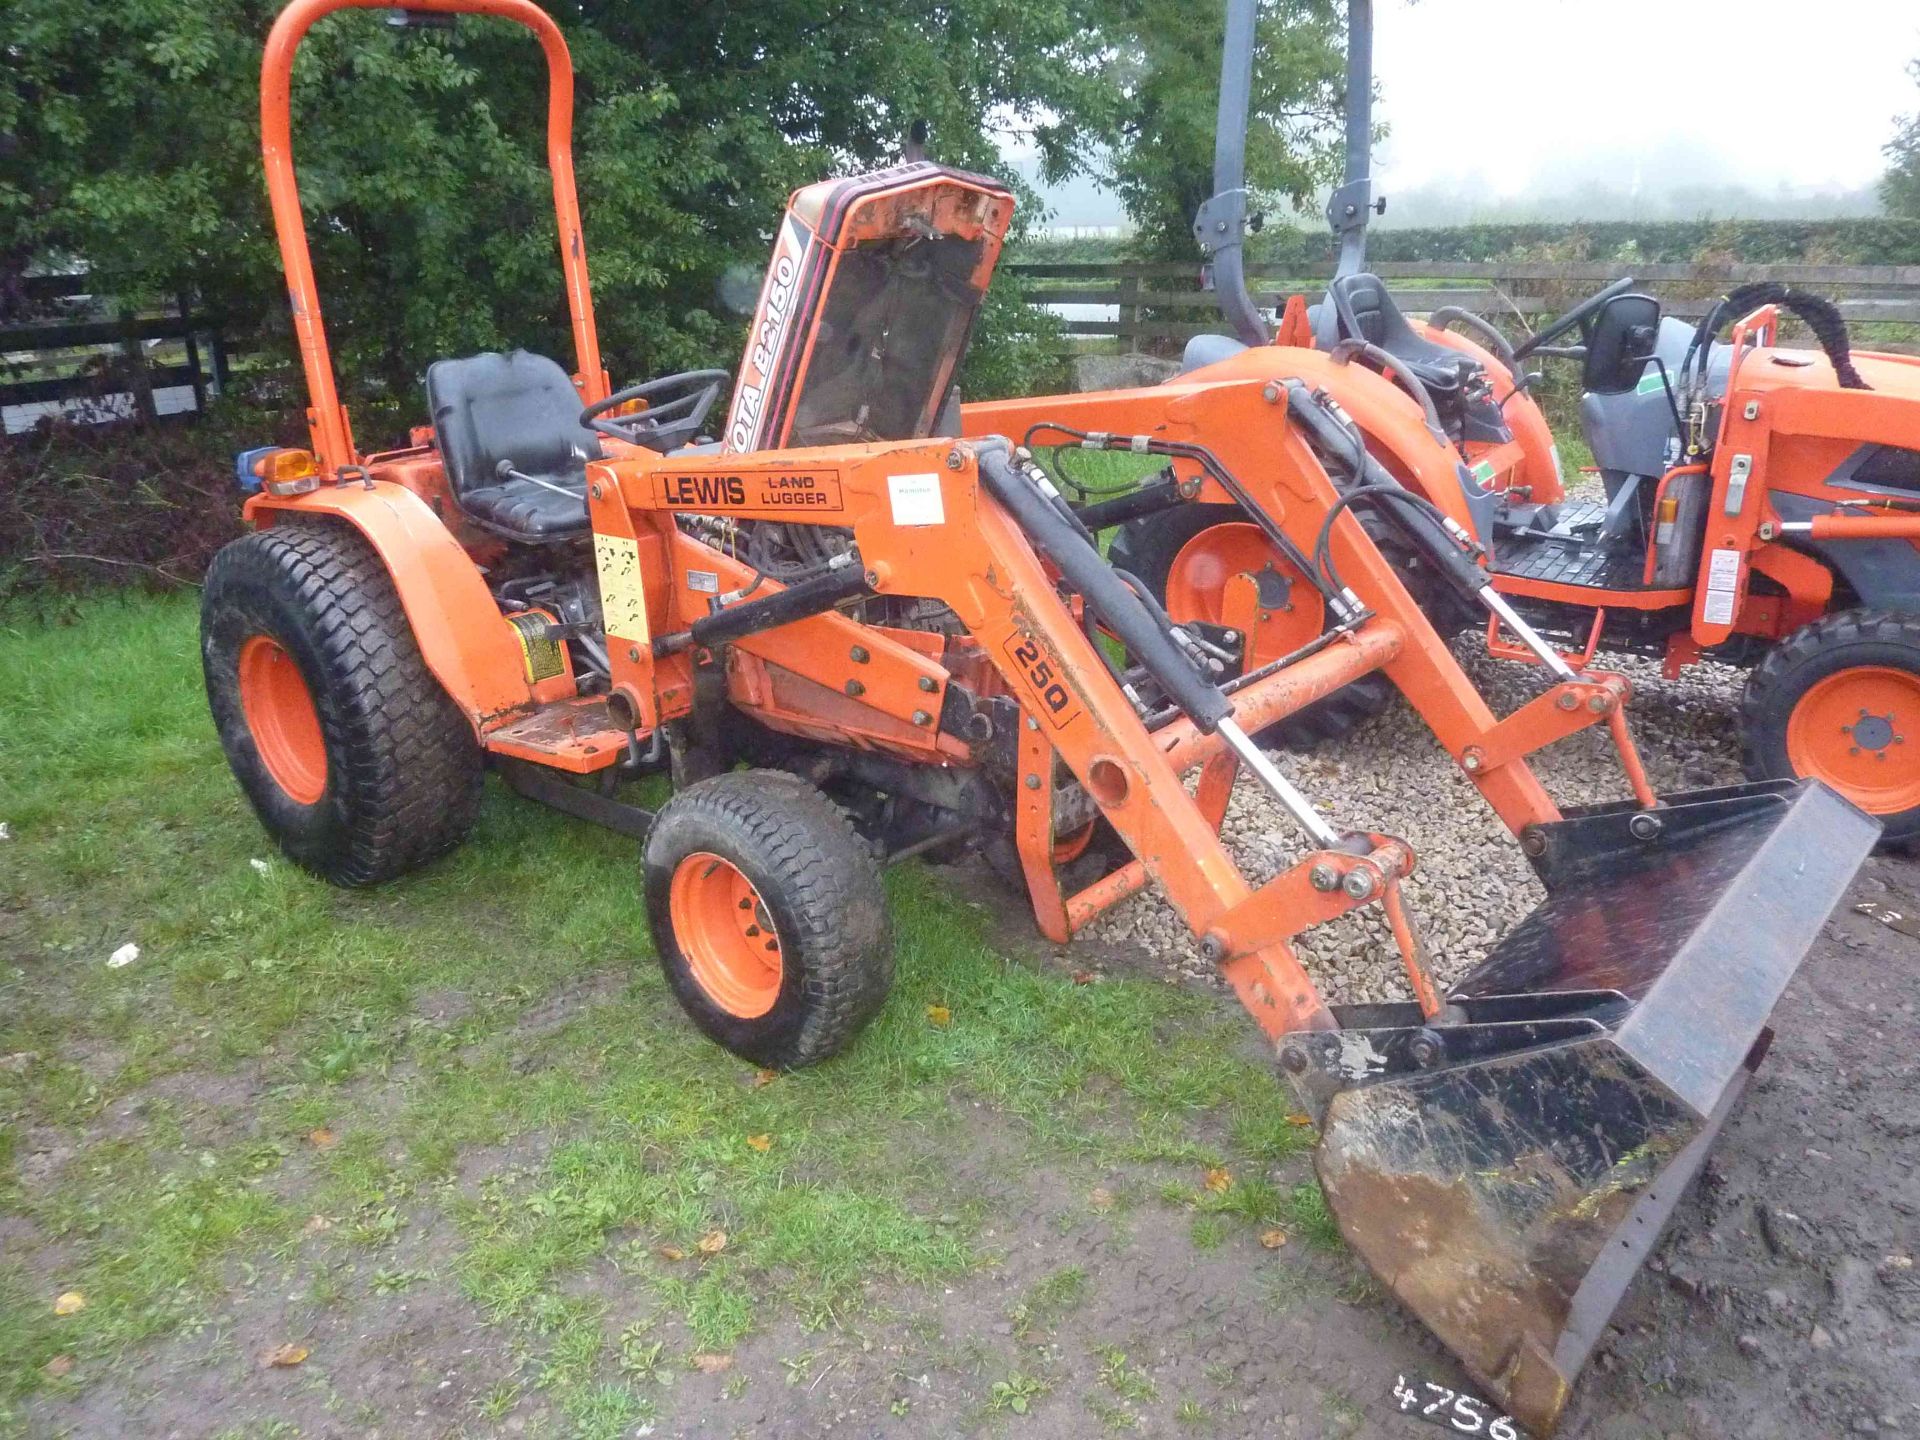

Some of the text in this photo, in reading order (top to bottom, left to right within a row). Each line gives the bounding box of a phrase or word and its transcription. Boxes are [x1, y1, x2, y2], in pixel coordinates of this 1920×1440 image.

[731, 255, 795, 453] OTA B2150
[663, 476, 746, 505] LEWIS
[761, 492, 827, 505] LUGGER
[767, 476, 815, 489] LAND
[1014, 640, 1069, 714] 25Q
[1393, 1374, 1517, 1440] 4756
